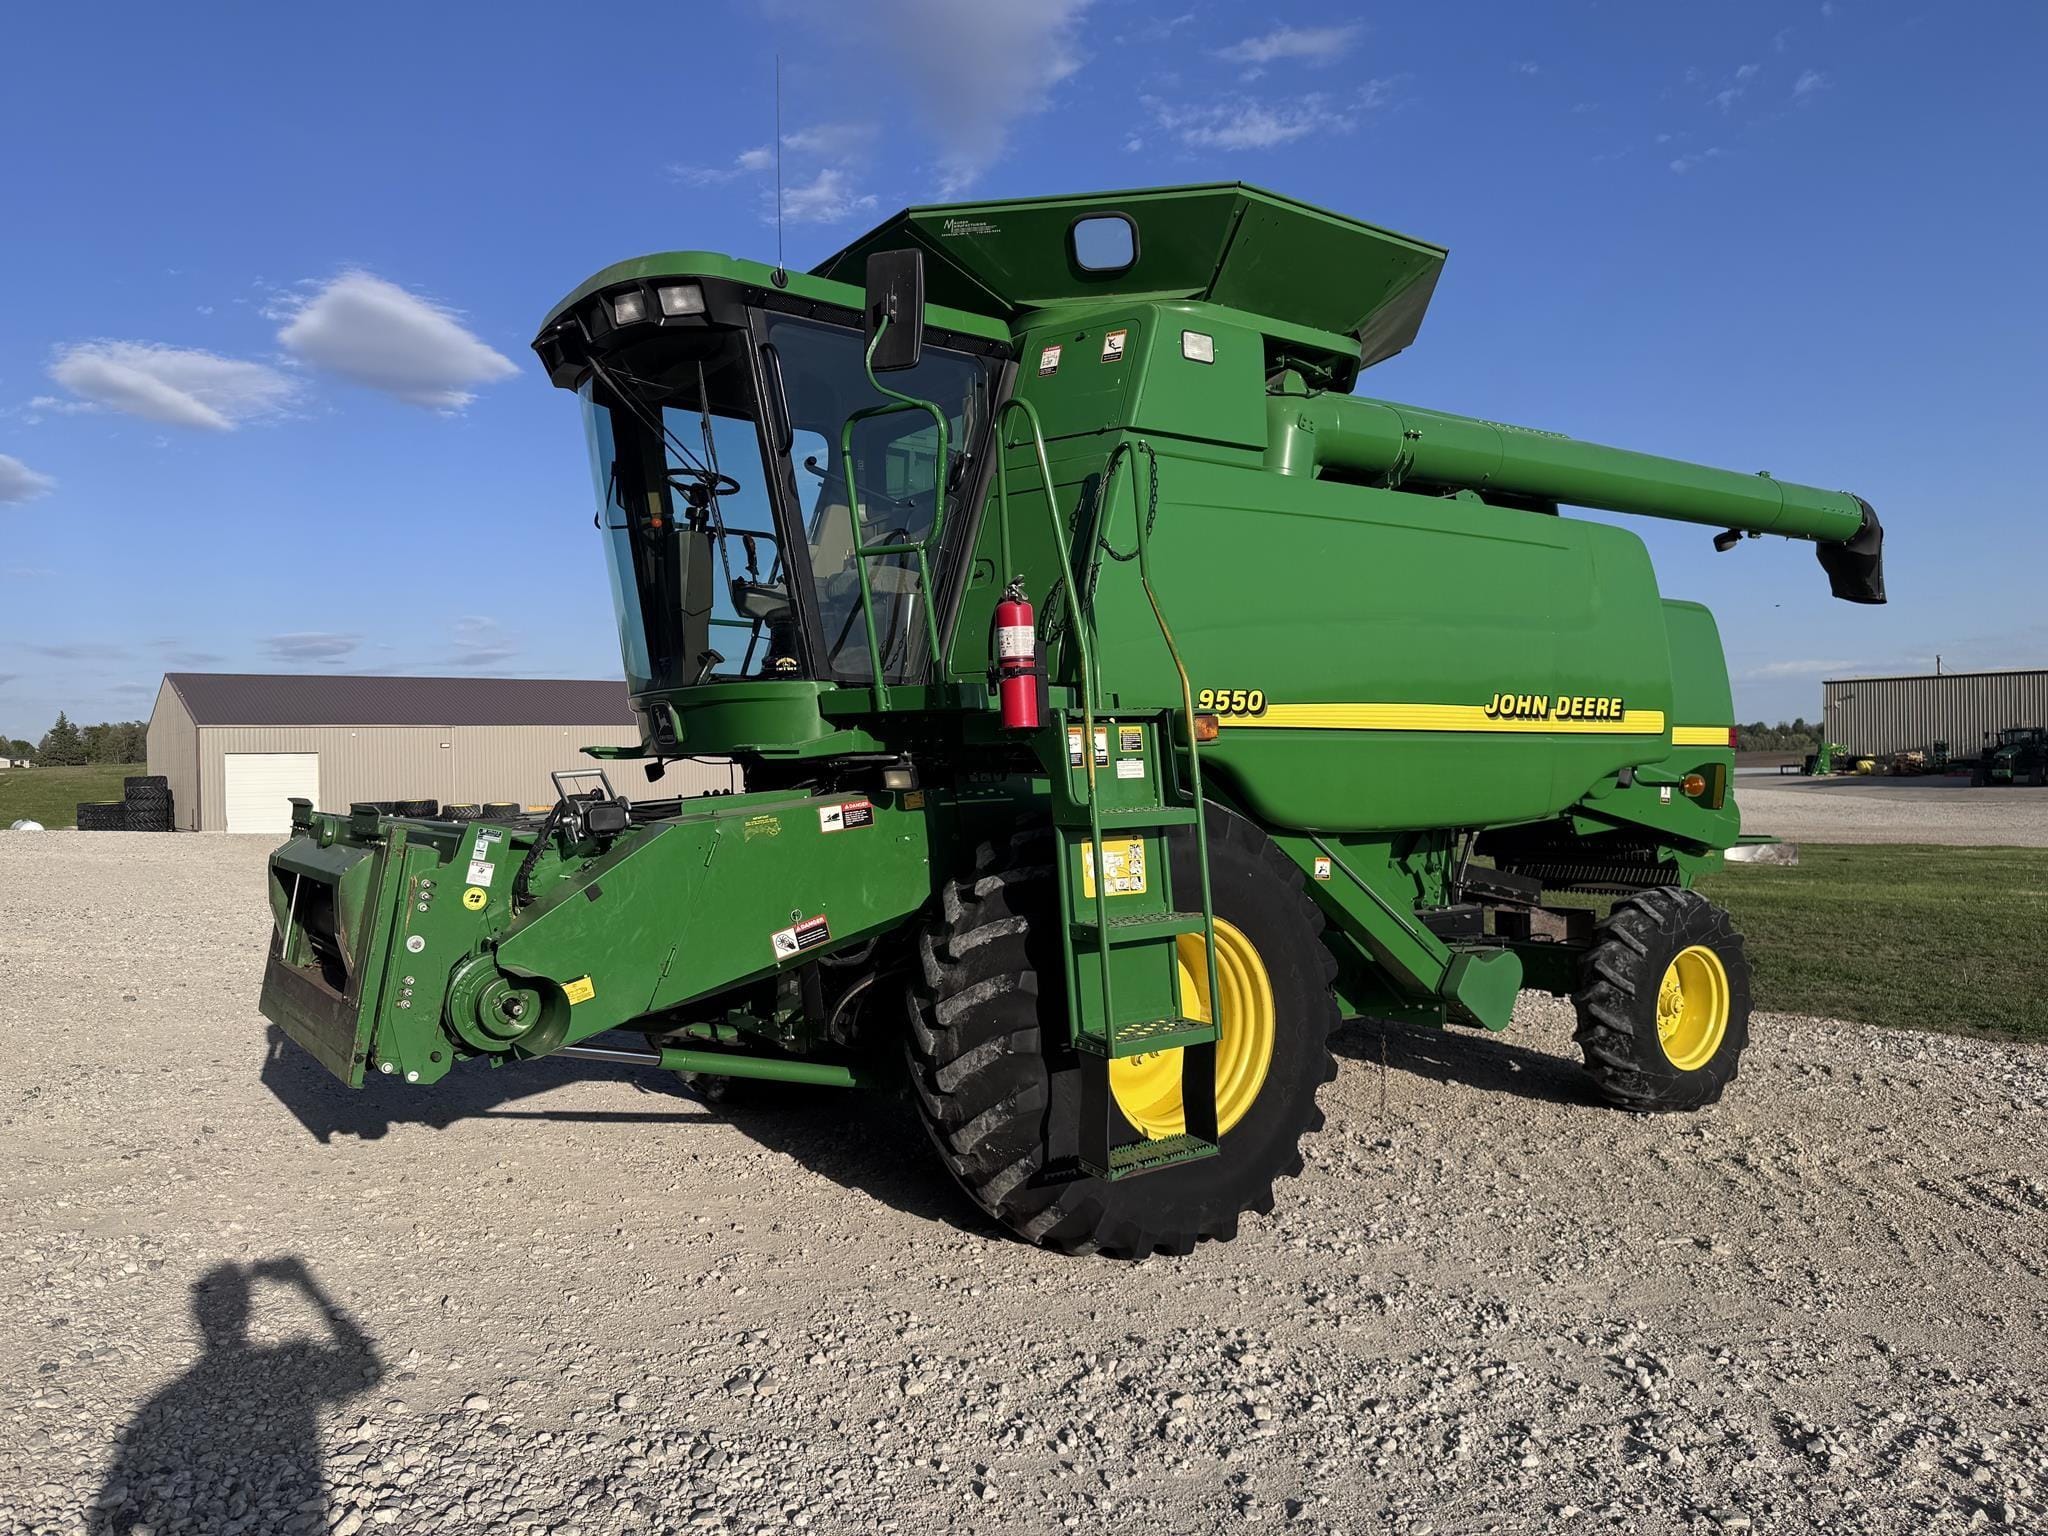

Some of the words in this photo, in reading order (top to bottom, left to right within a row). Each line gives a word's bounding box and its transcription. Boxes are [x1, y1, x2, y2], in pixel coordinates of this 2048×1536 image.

[1198, 689, 1265, 714] 9550
[1484, 693, 1549, 718] JOHN
[1555, 695, 1624, 720] DEERE
[849, 801, 869, 809] DANGER
[800, 917, 825, 930] DANGER
